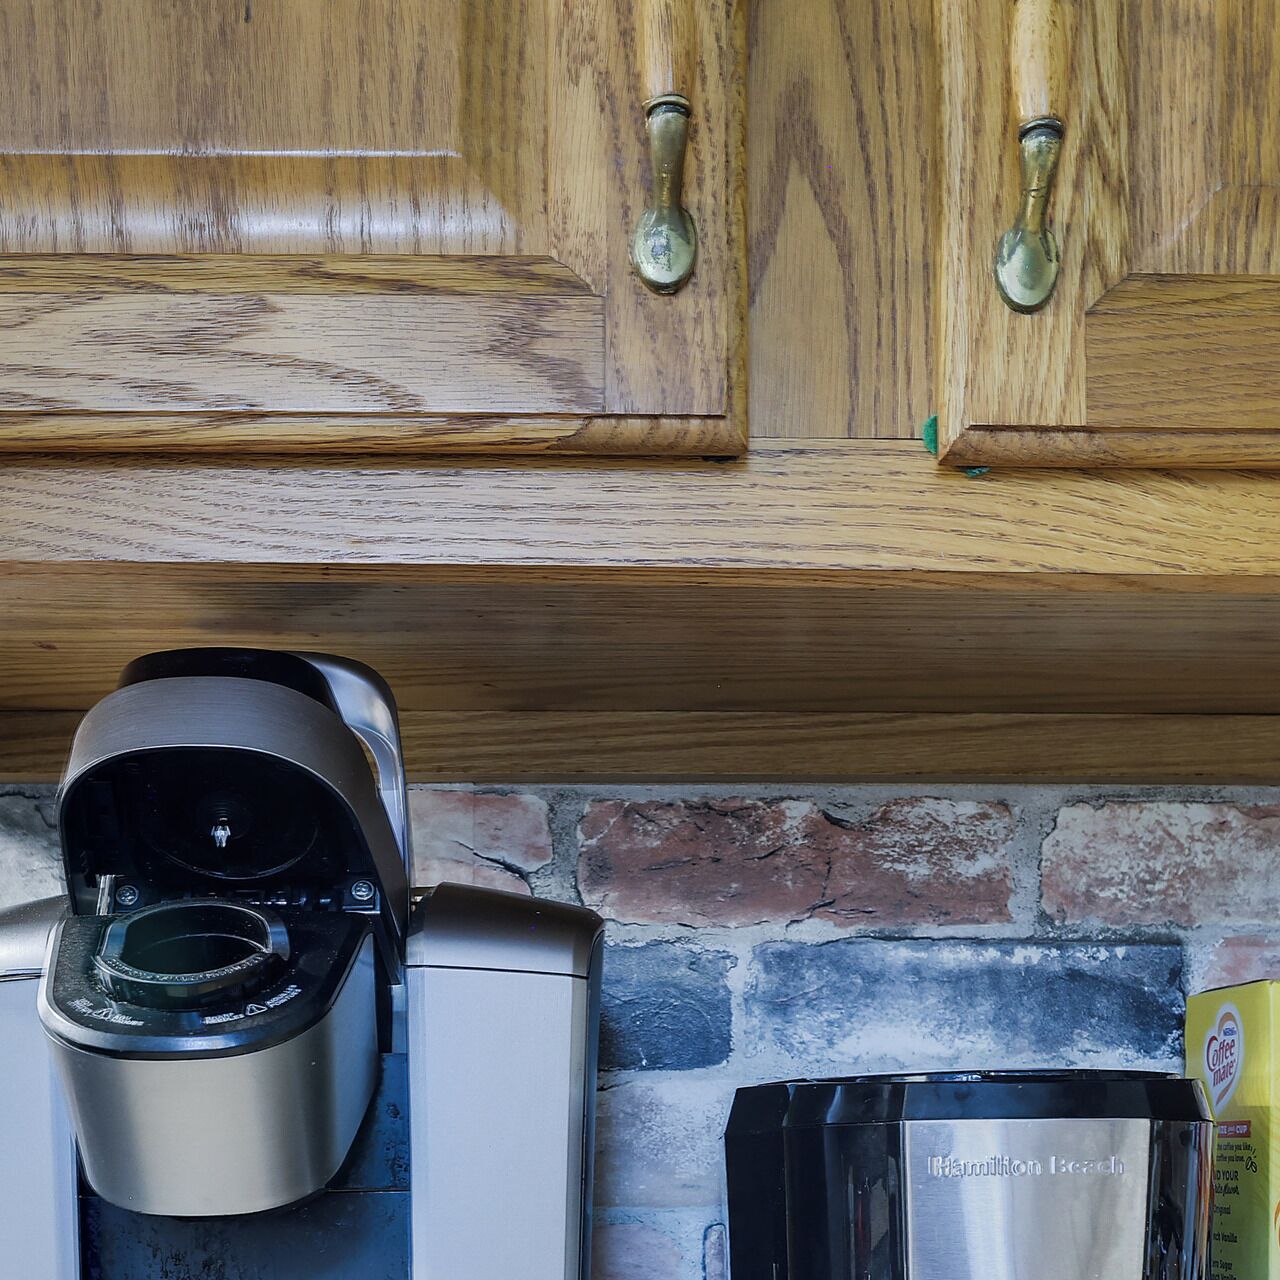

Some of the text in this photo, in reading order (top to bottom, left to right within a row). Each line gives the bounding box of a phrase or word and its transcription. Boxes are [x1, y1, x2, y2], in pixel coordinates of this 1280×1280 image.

[1207, 1035, 1235, 1072] Coffee
[1213, 1060, 1233, 1087] mate
[928, 1155, 1043, 1178] Hamilton
